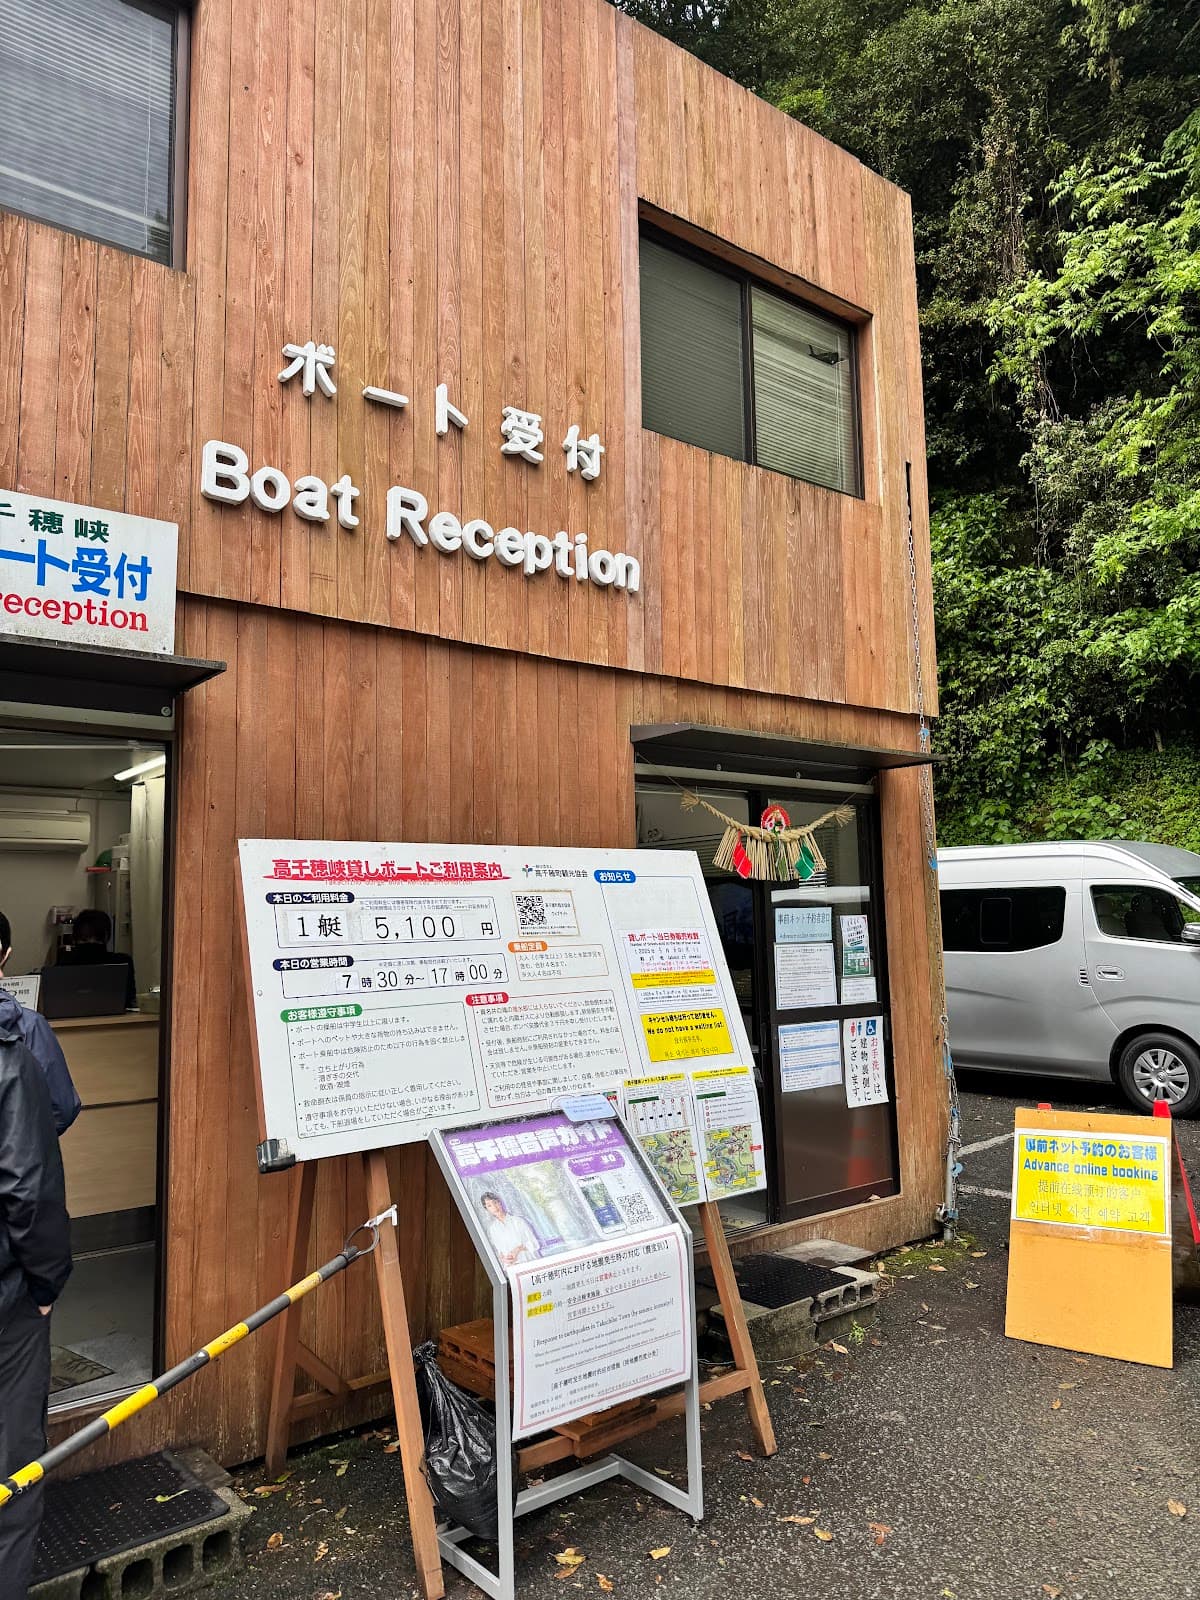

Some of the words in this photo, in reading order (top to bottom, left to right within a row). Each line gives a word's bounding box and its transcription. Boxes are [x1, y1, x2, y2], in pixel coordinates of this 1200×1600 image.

[277, 341, 605, 480] ボート受付
[201, 439, 360, 529] Boat
[386, 485, 640, 593] Reception
[0, 591, 149, 632] eception
[272, 859, 503, 879] 高千穂峡貸しボートご利用案内
[599, 872, 631, 881] お知らせ
[273, 893, 348, 904] 本日のご利用料金
[375, 915, 456, 940] 5,100
[481, 922, 494, 936] 円
[280, 957, 348, 969] 本日の営業時間
[471, 994, 503, 1004] 注意事項
[287, 1005, 356, 1021] お客様遵守事項
[1025, 1138, 1157, 1161] 事前ネット予約のお客様
[1024, 1158, 1070, 1173] Advance
[1074, 1163, 1107, 1176] online
[1113, 1165, 1158, 1181] booking
